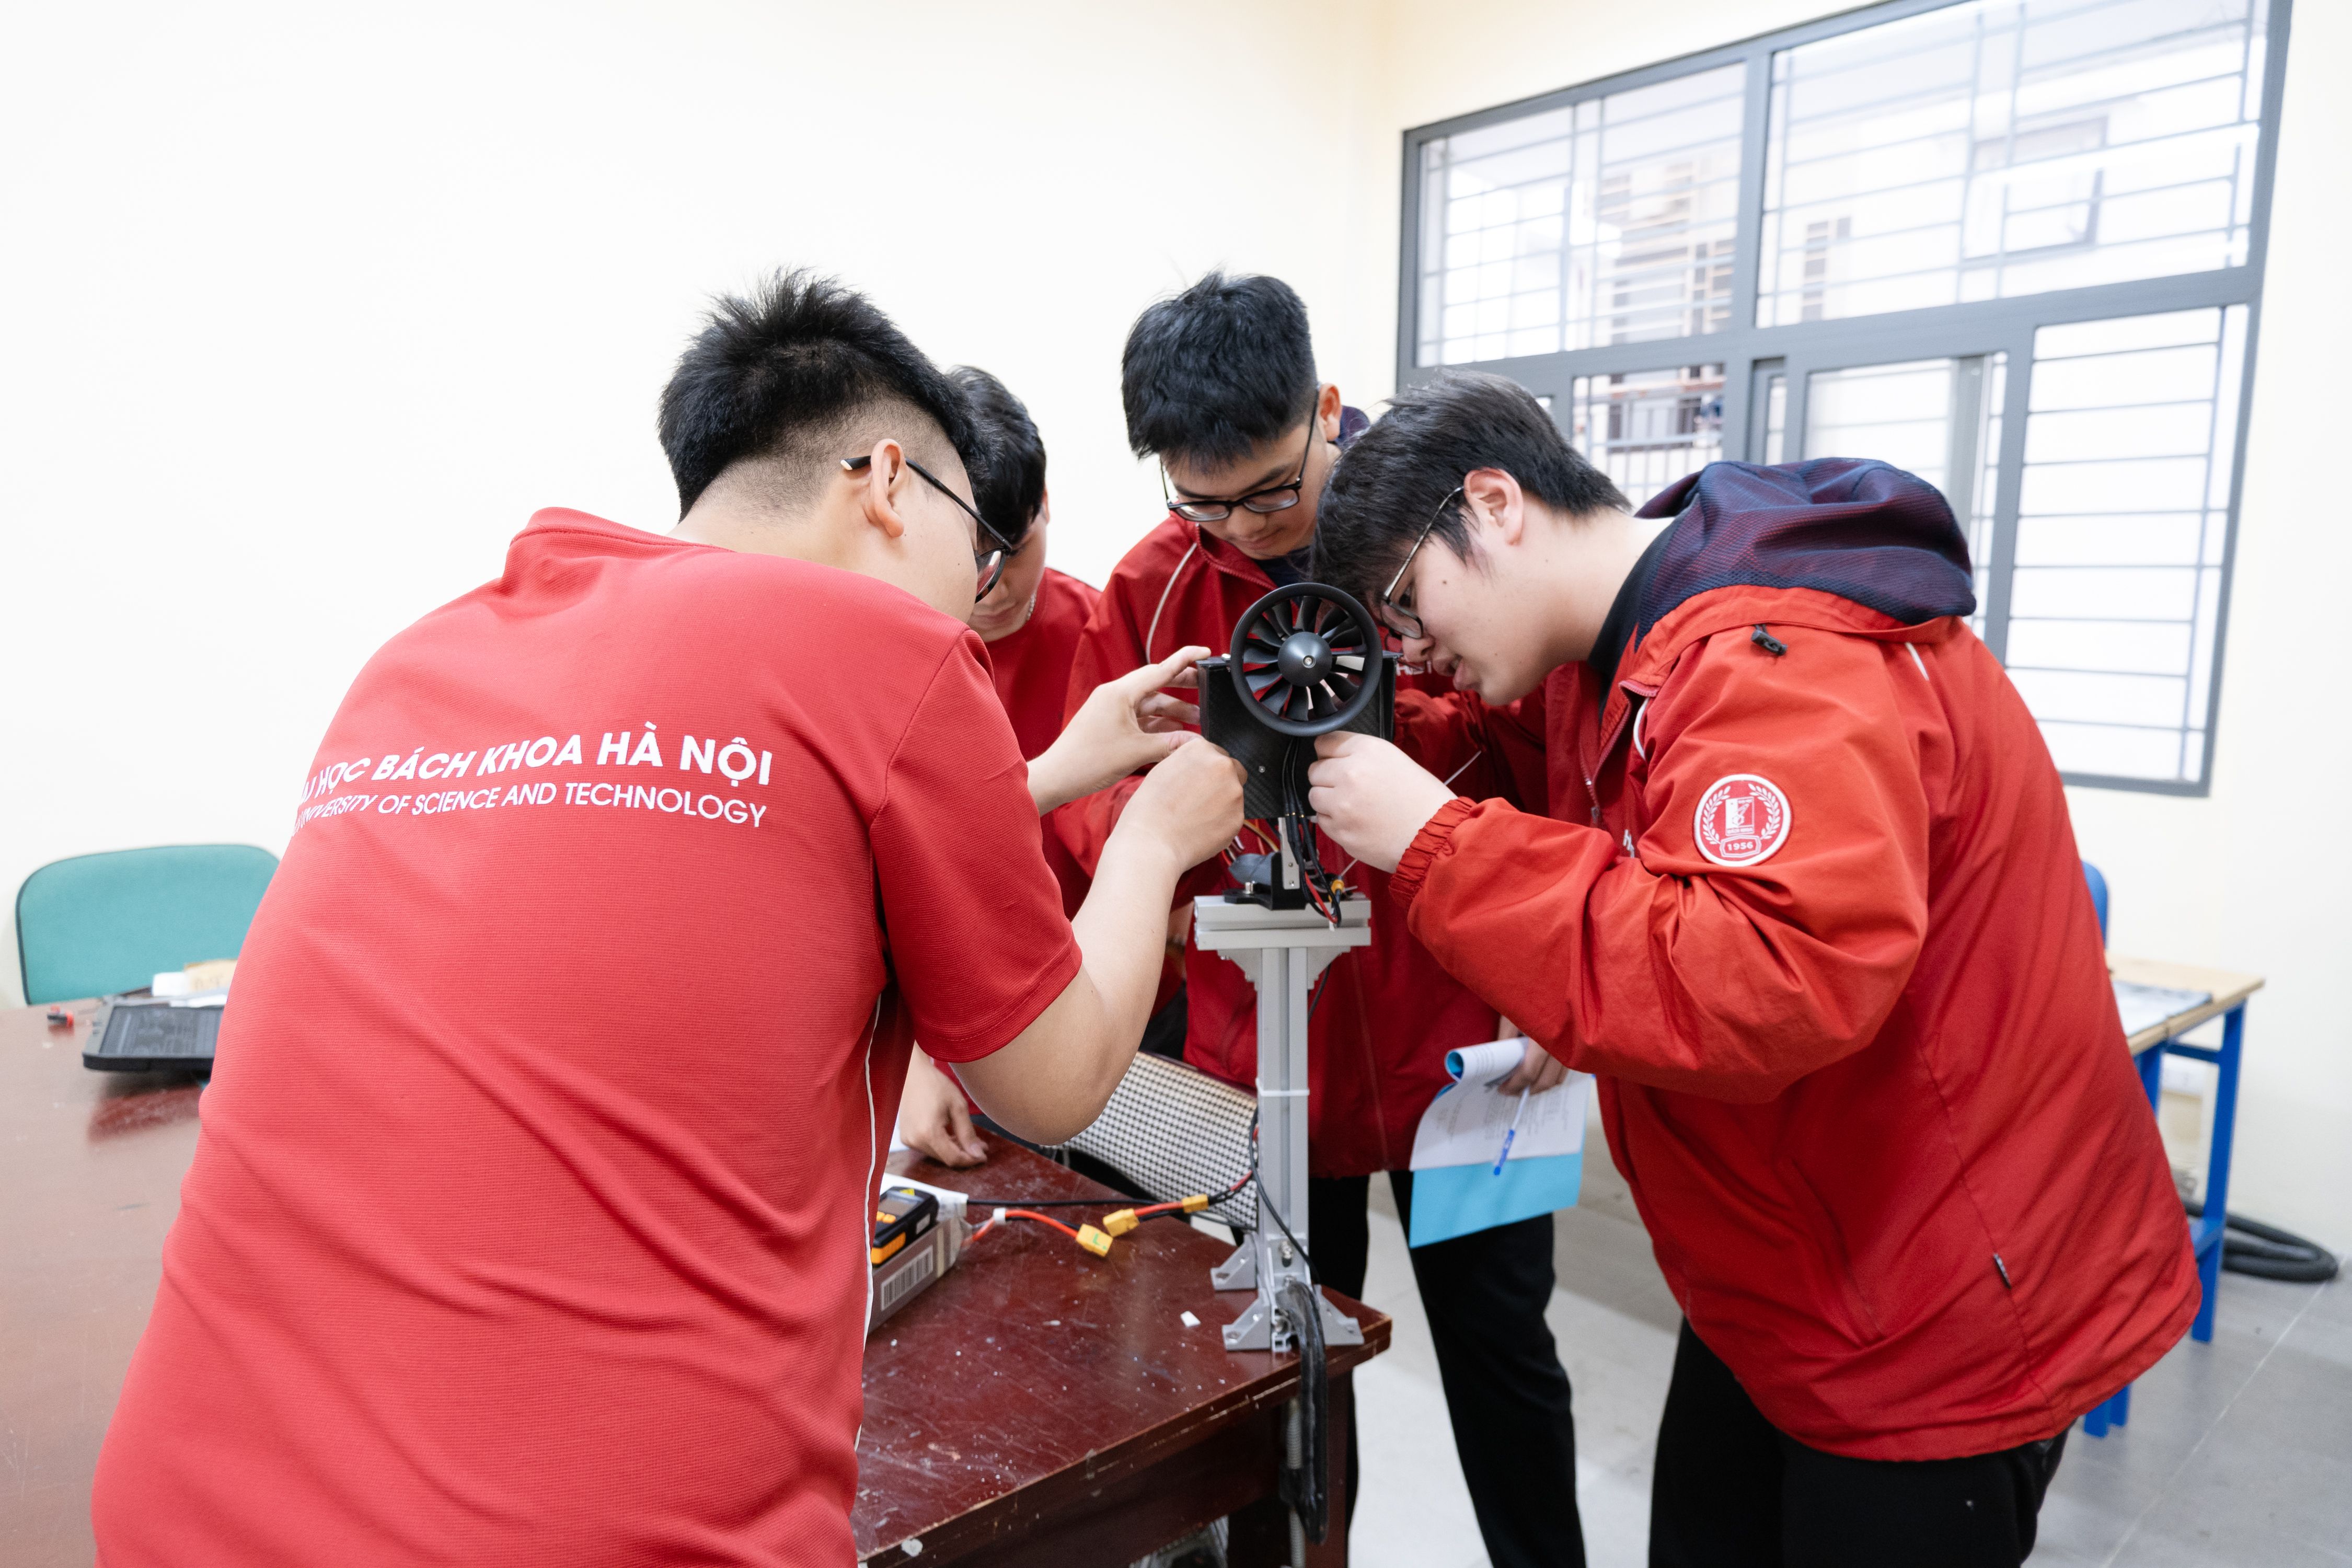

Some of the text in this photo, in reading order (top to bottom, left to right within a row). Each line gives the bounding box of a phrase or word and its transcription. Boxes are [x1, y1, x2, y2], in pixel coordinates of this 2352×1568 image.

[315, 757, 371, 799] HỌC
[371, 746, 477, 780] BÁCH
[476, 734, 583, 777] KHOA
[597, 721, 663, 767] HÀ
[680, 736, 773, 787] NỘI
[300, 794, 379, 828] UNIVERSITY
[378, 794, 412, 814] OF
[411, 787, 502, 815] SCIENCE
[501, 782, 557, 806] AND
[566, 782, 767, 828] TECHNOLOGY
[1727, 841, 1754, 851] 1956
